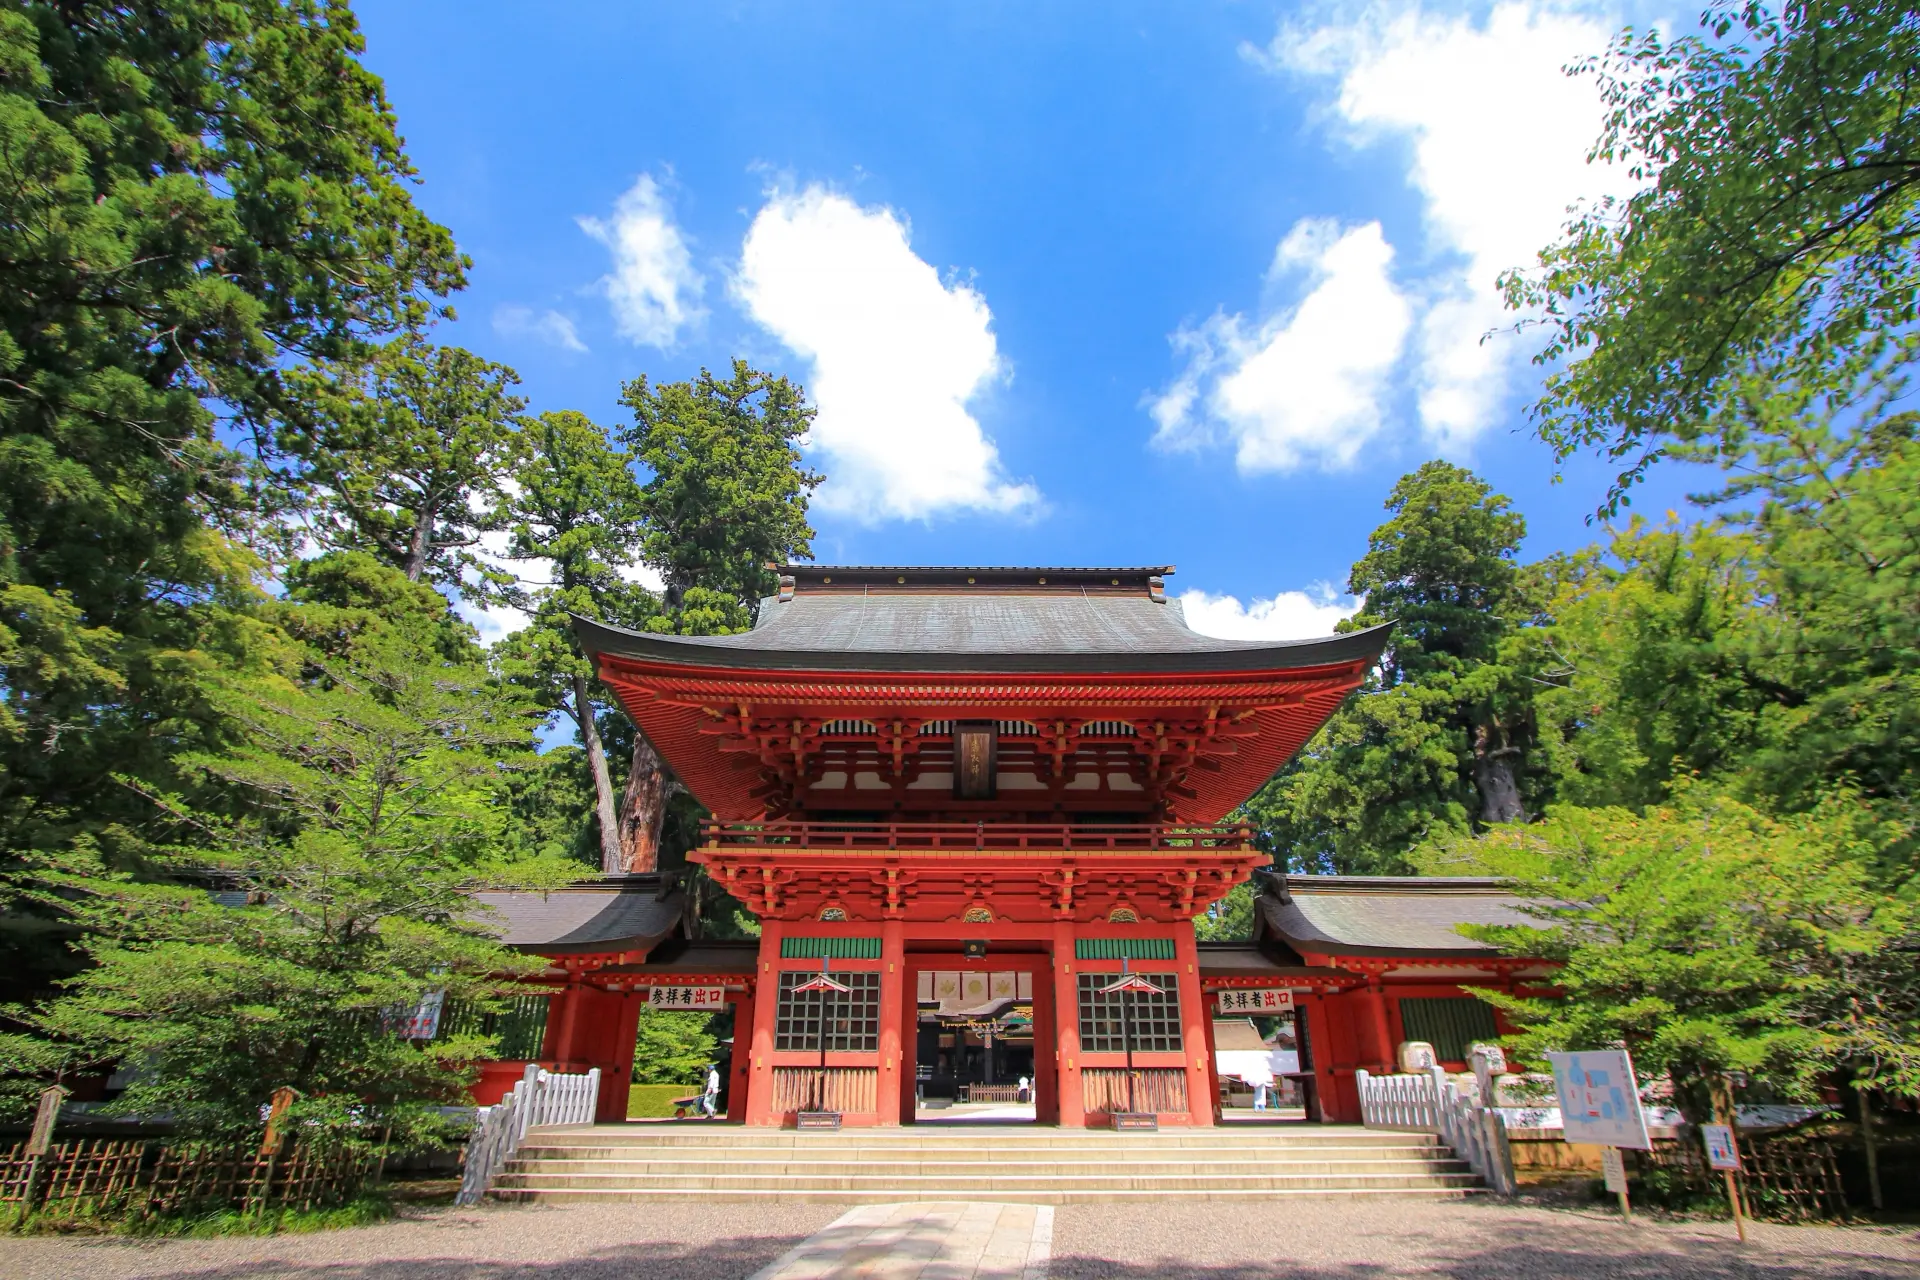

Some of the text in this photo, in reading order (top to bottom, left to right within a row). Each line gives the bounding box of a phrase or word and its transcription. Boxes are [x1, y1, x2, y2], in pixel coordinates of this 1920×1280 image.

[652, 988, 721, 1005] 参拝者出口
[1223, 991, 1289, 1009] 参拝者出口
